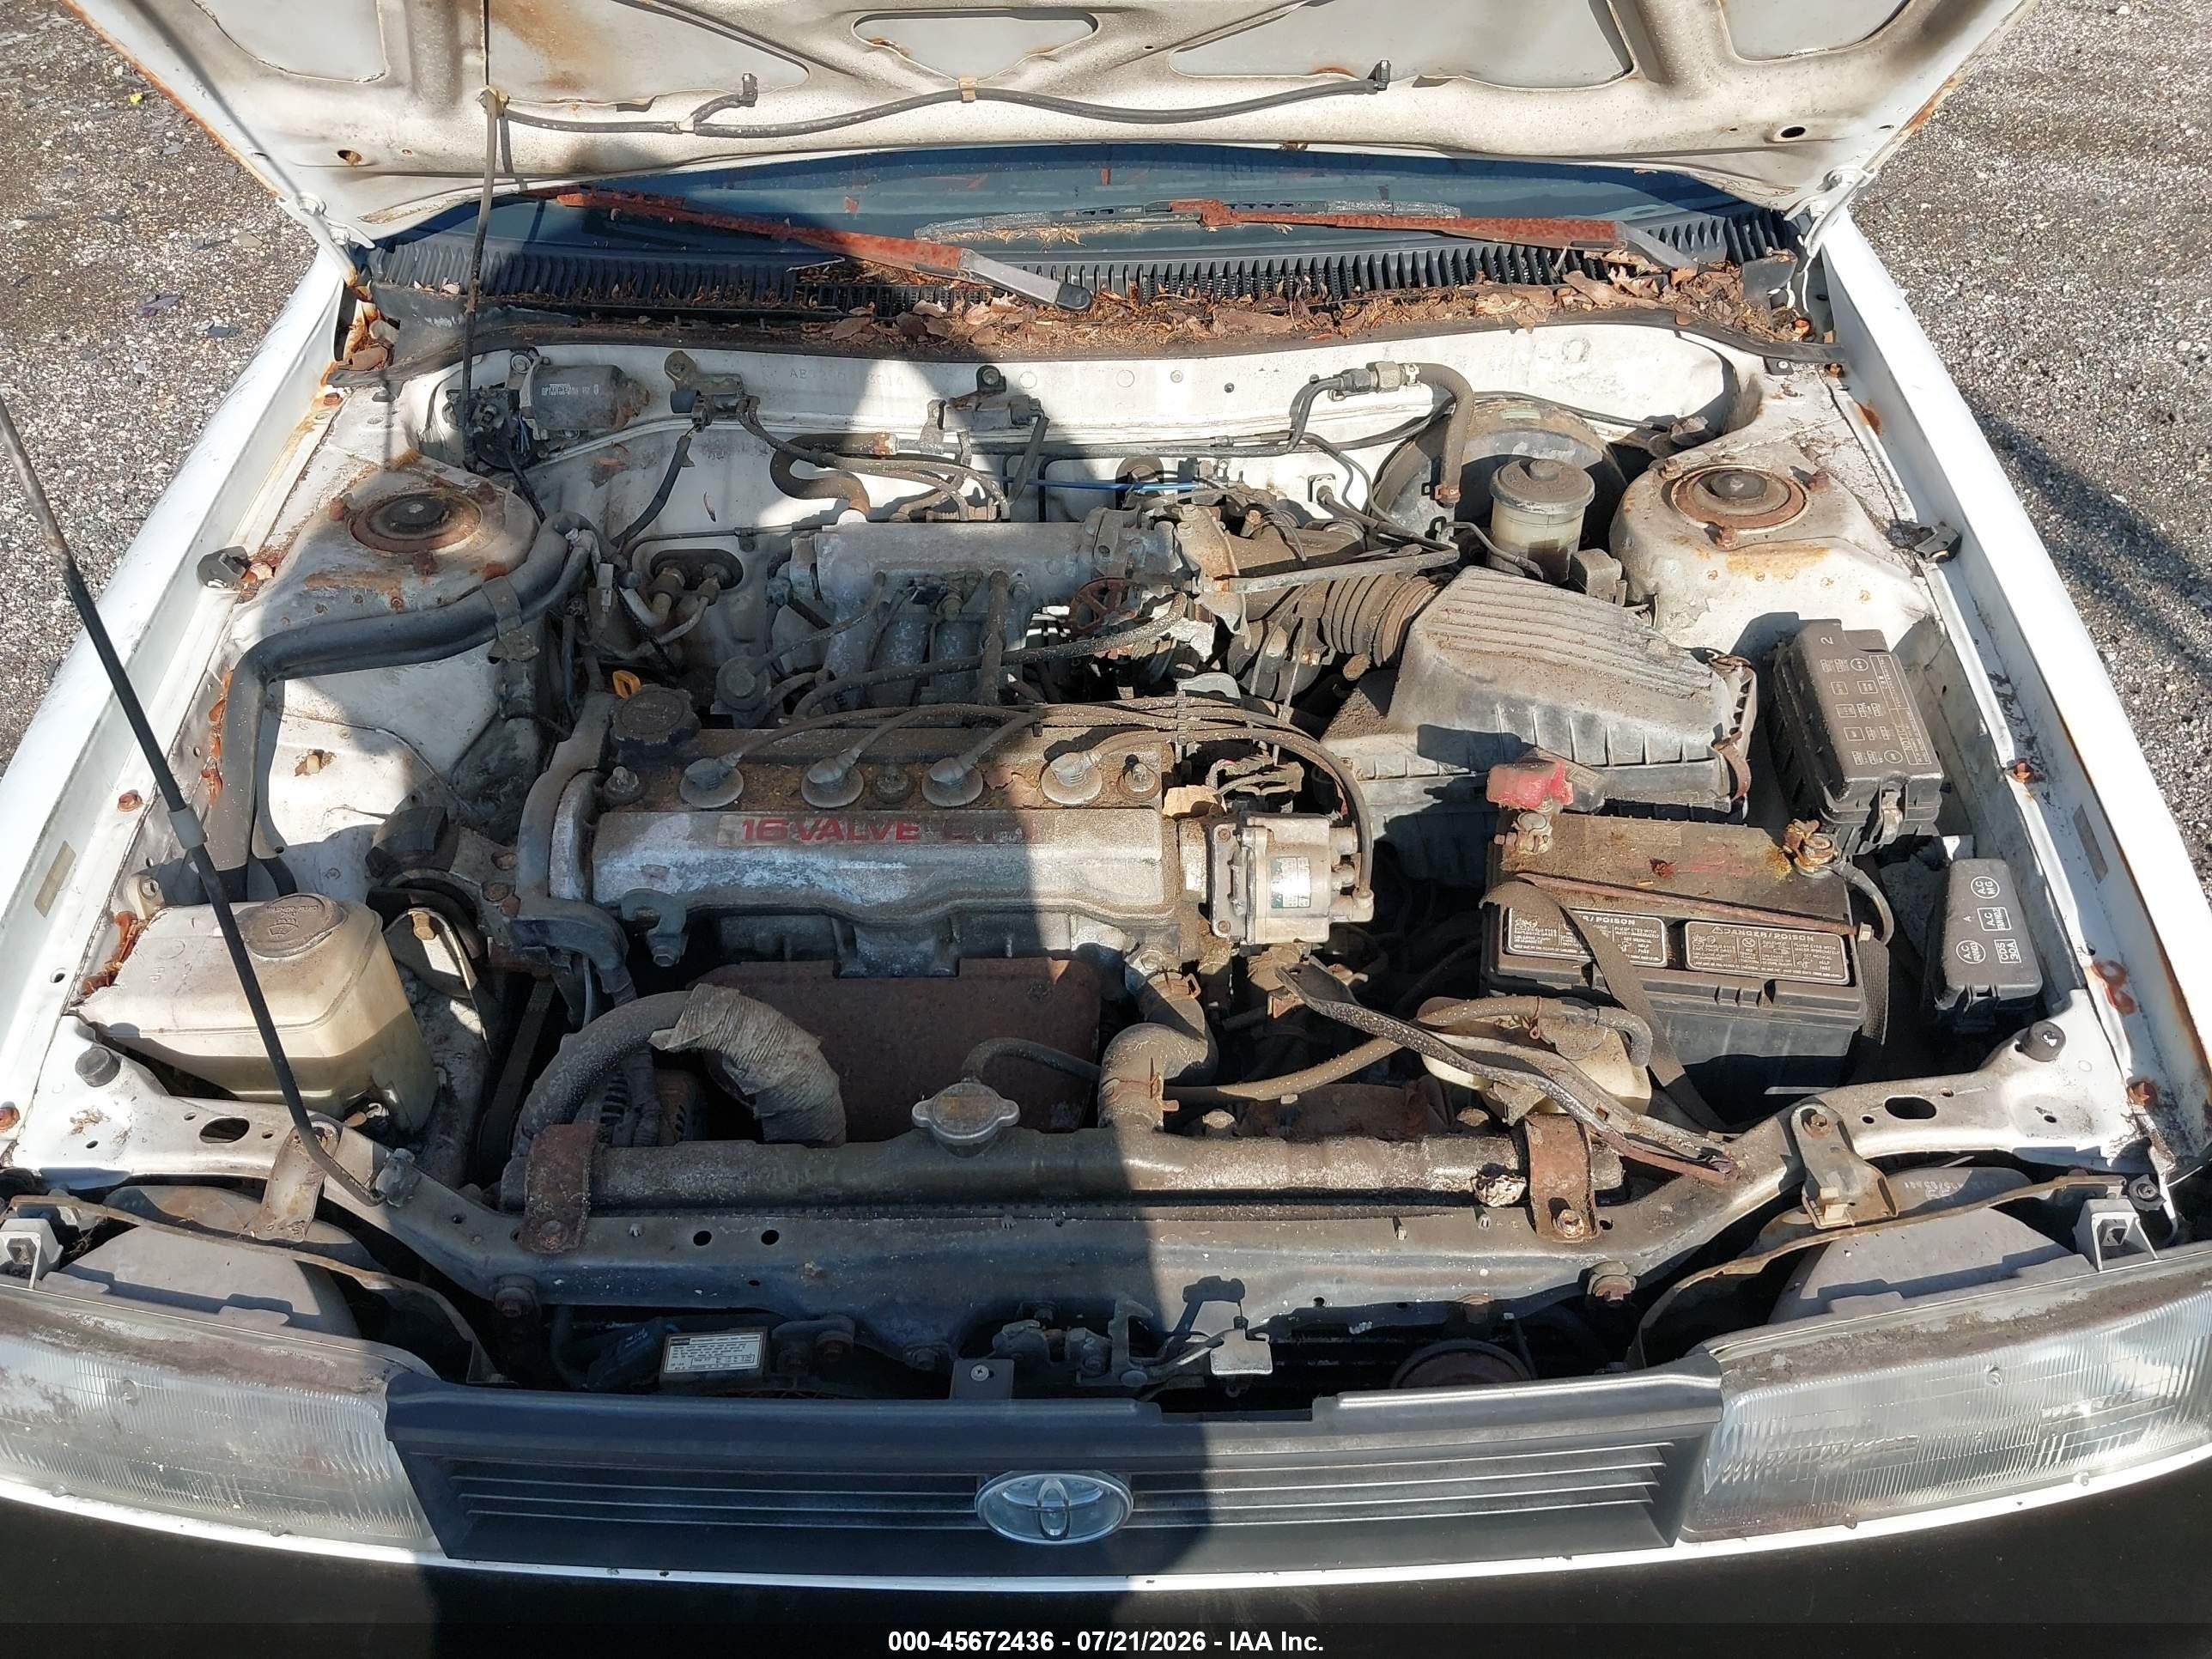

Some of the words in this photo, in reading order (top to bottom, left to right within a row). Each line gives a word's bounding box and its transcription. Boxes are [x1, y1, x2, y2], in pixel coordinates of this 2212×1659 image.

[1820, 636, 1834, 645] 2
[741, 818, 789, 841] 16
[794, 818, 921, 841] VALVE
[1985, 880, 1996, 895] MG
[1997, 943, 2008, 960] CDS
[2008, 942, 2019, 960] 30A
